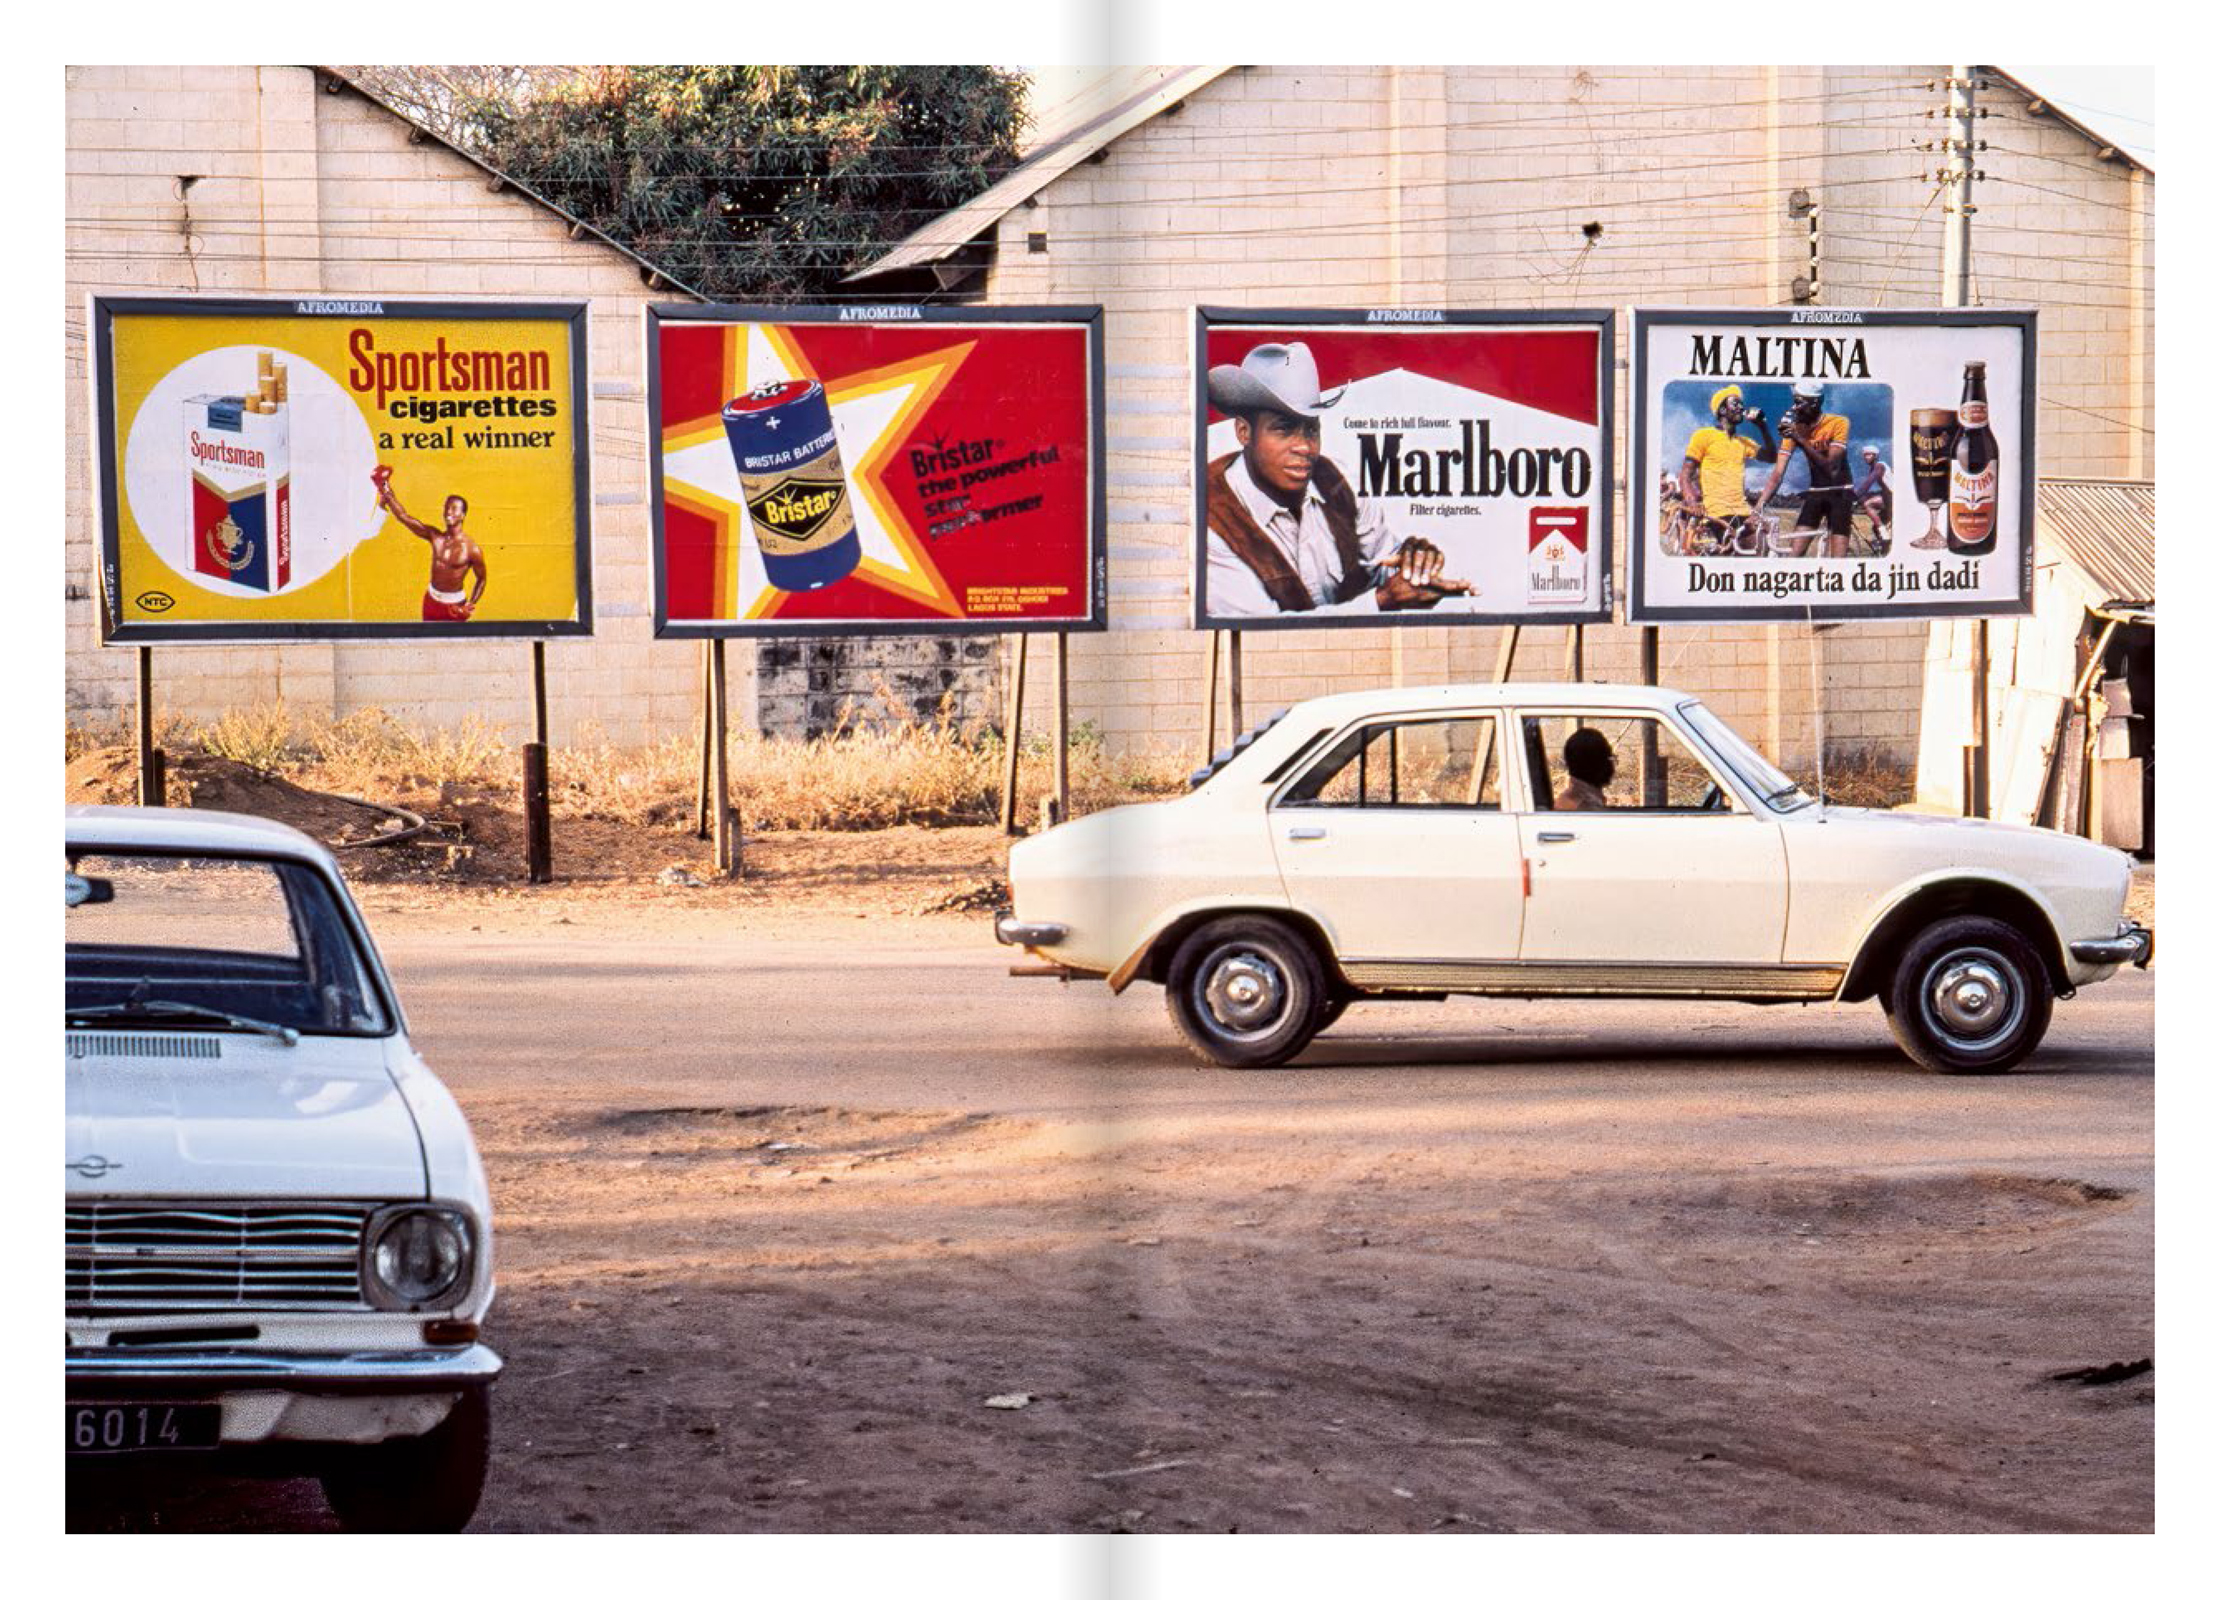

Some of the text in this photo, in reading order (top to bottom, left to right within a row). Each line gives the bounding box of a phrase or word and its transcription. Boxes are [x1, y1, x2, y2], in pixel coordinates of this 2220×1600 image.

[297, 301, 384, 315] AFROMEDIA
[839, 307, 922, 320] AFROMEDIA
[1367, 310, 1444, 322] AFROMEDIA
[350, 328, 550, 410] Sportsman
[1689, 335, 1871, 378] MALTINA
[390, 397, 557, 423] cigarettes
[1343, 416, 1368, 429] Come
[1381, 416, 1399, 429] rich
[191, 430, 265, 468] Sportsman
[379, 426, 555, 449] a real winner
[744, 450, 792, 468] BRISTAR
[911, 439, 993, 478] Bristar
[918, 445, 1061, 498] the powerful
[1357, 419, 1592, 498] Marlboro
[764, 490, 831, 524] Bristar
[1409, 503, 1435, 516] Filter
[1688, 563, 1736, 593] Don
[1852, 562, 1882, 592] da
[1888, 563, 1920, 599] jin
[1927, 560, 1979, 590] dadi
[144, 597, 167, 606] NTC
[75, 1408, 178, 1447] 6014
